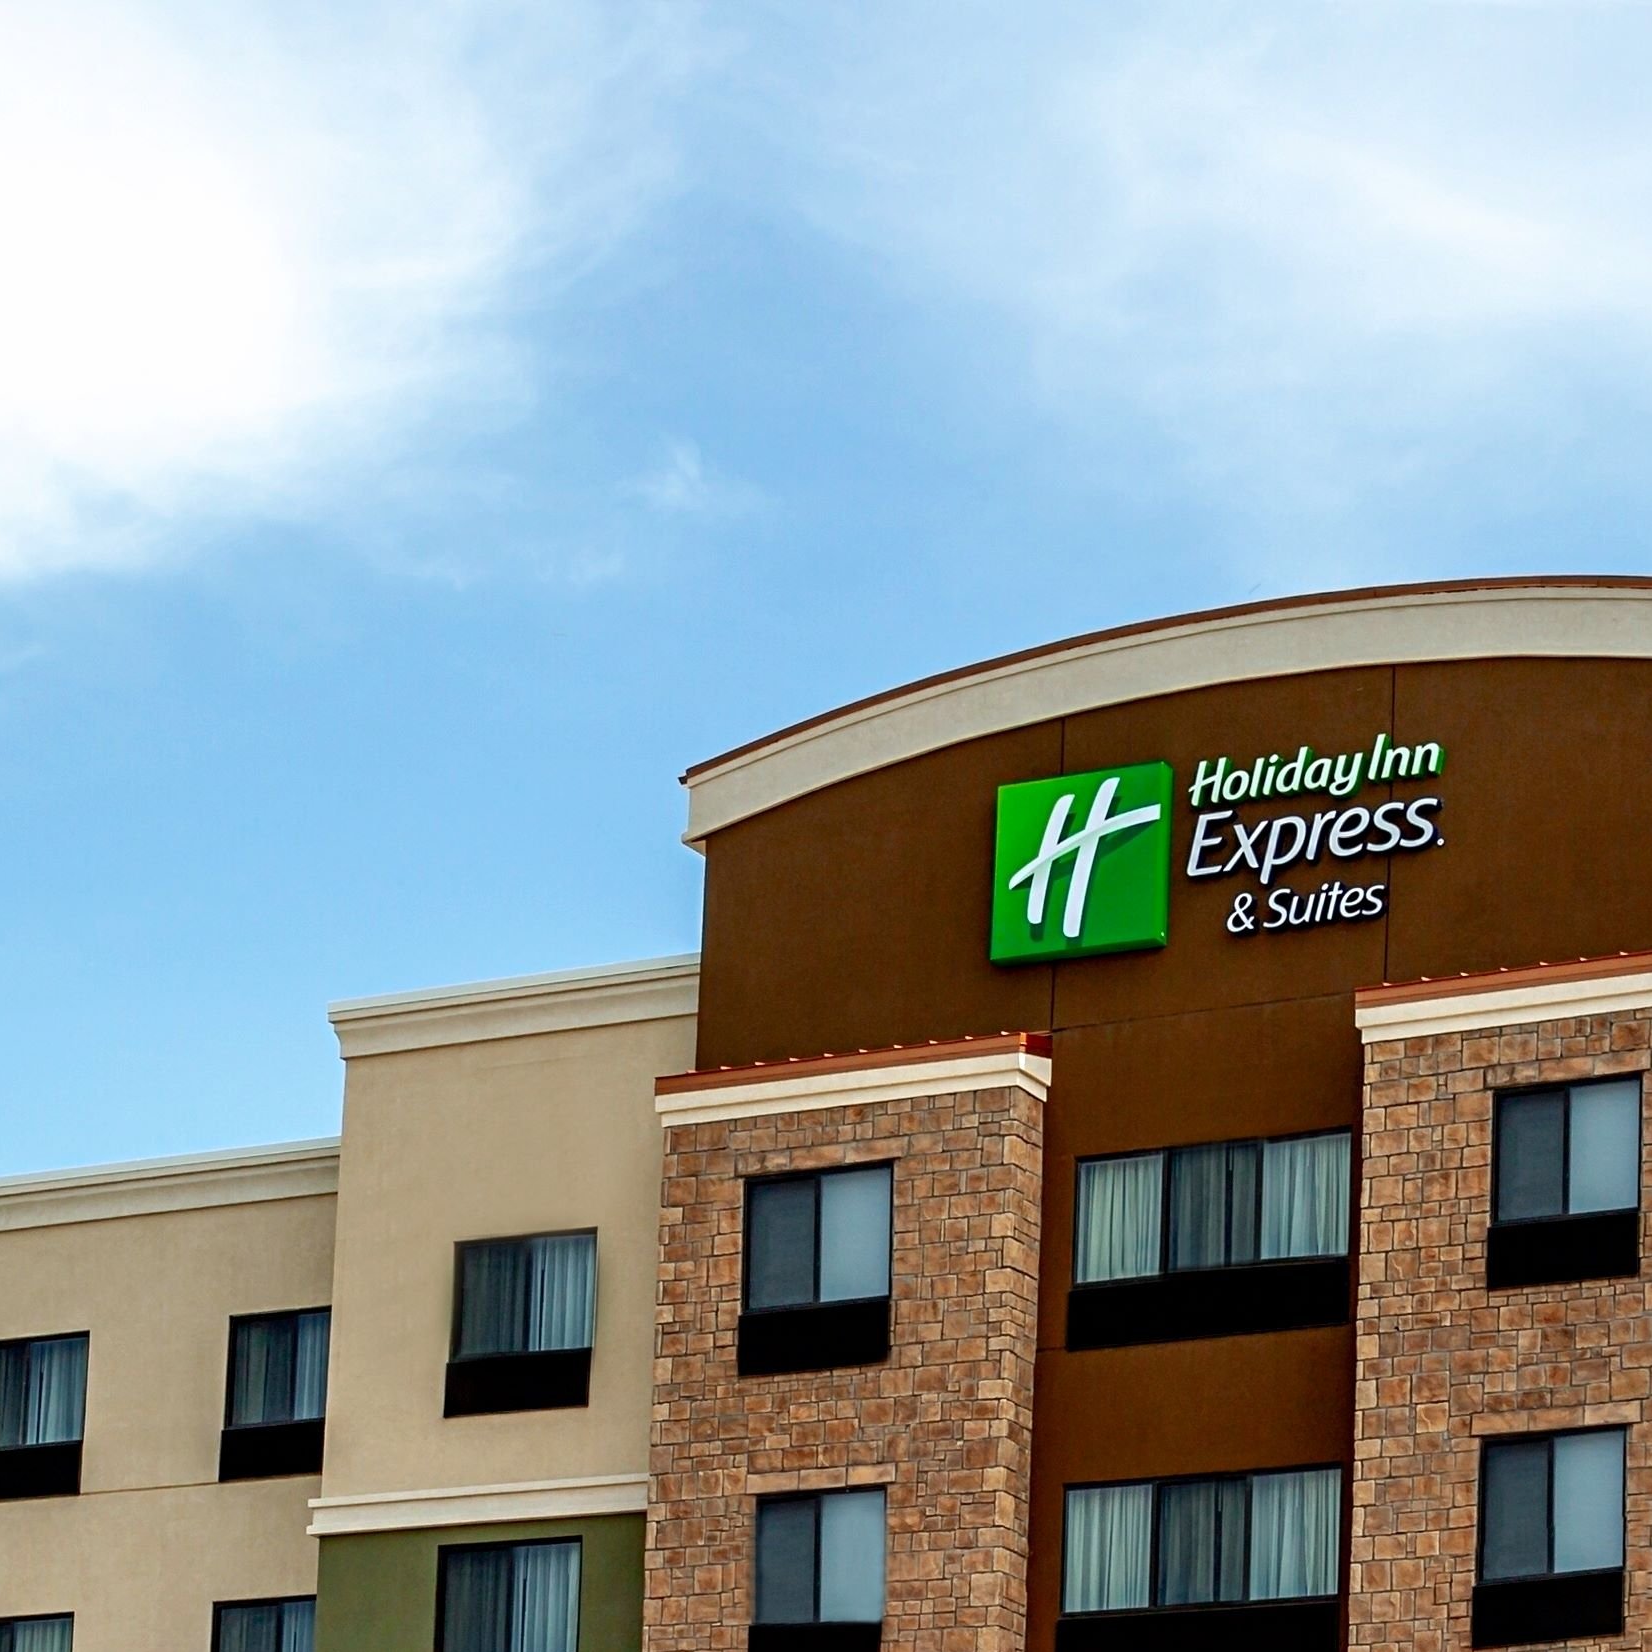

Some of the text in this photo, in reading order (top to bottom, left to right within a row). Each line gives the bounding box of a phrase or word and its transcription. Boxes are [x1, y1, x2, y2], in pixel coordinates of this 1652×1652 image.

[1188, 733, 1441, 807] Holiday Inn
[1186, 797, 1439, 885] Express
[1226, 881, 1385, 932] & Suites
